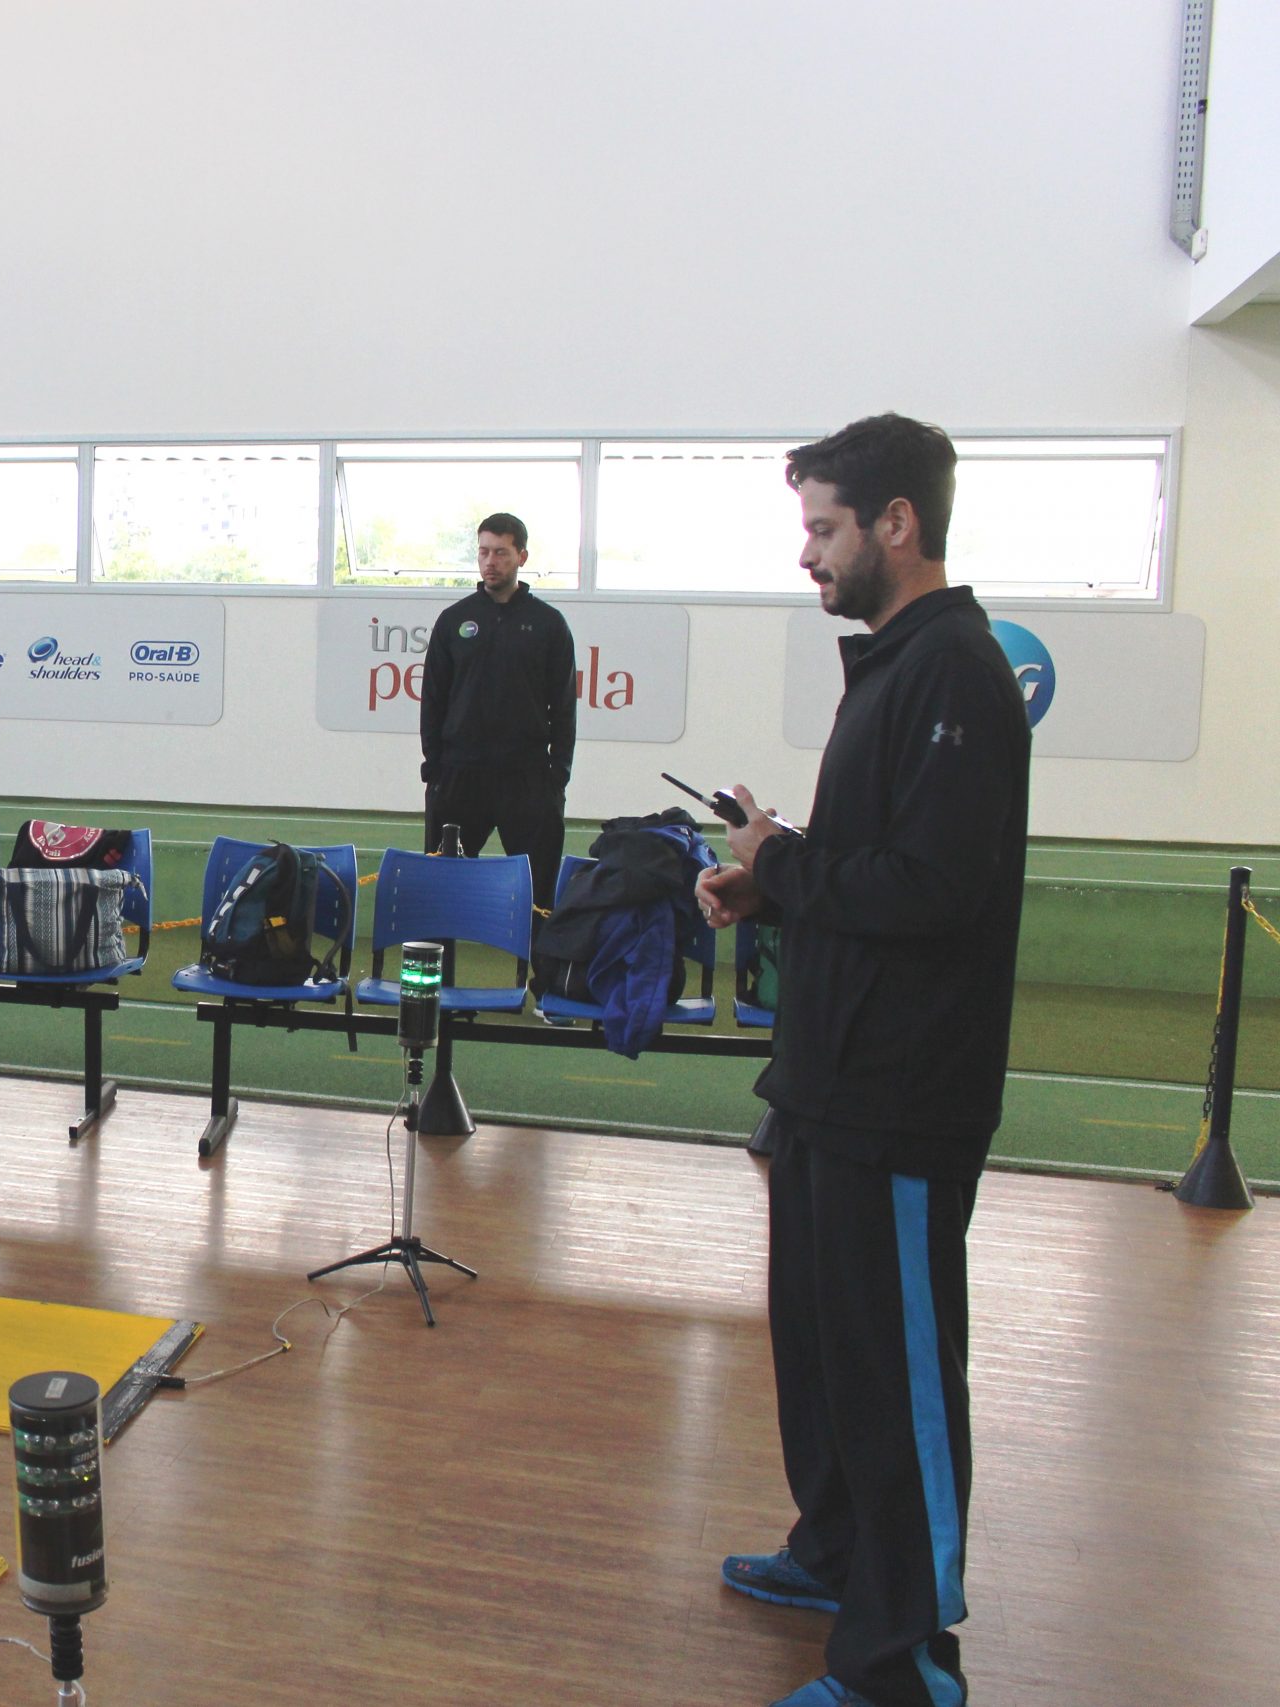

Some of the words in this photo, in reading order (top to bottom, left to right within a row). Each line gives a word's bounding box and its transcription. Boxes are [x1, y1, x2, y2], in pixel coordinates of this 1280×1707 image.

[135, 645, 192, 662] Oral-B
[28, 665, 101, 681] shoulders
[129, 670, 200, 683] PRO-SAÚDE
